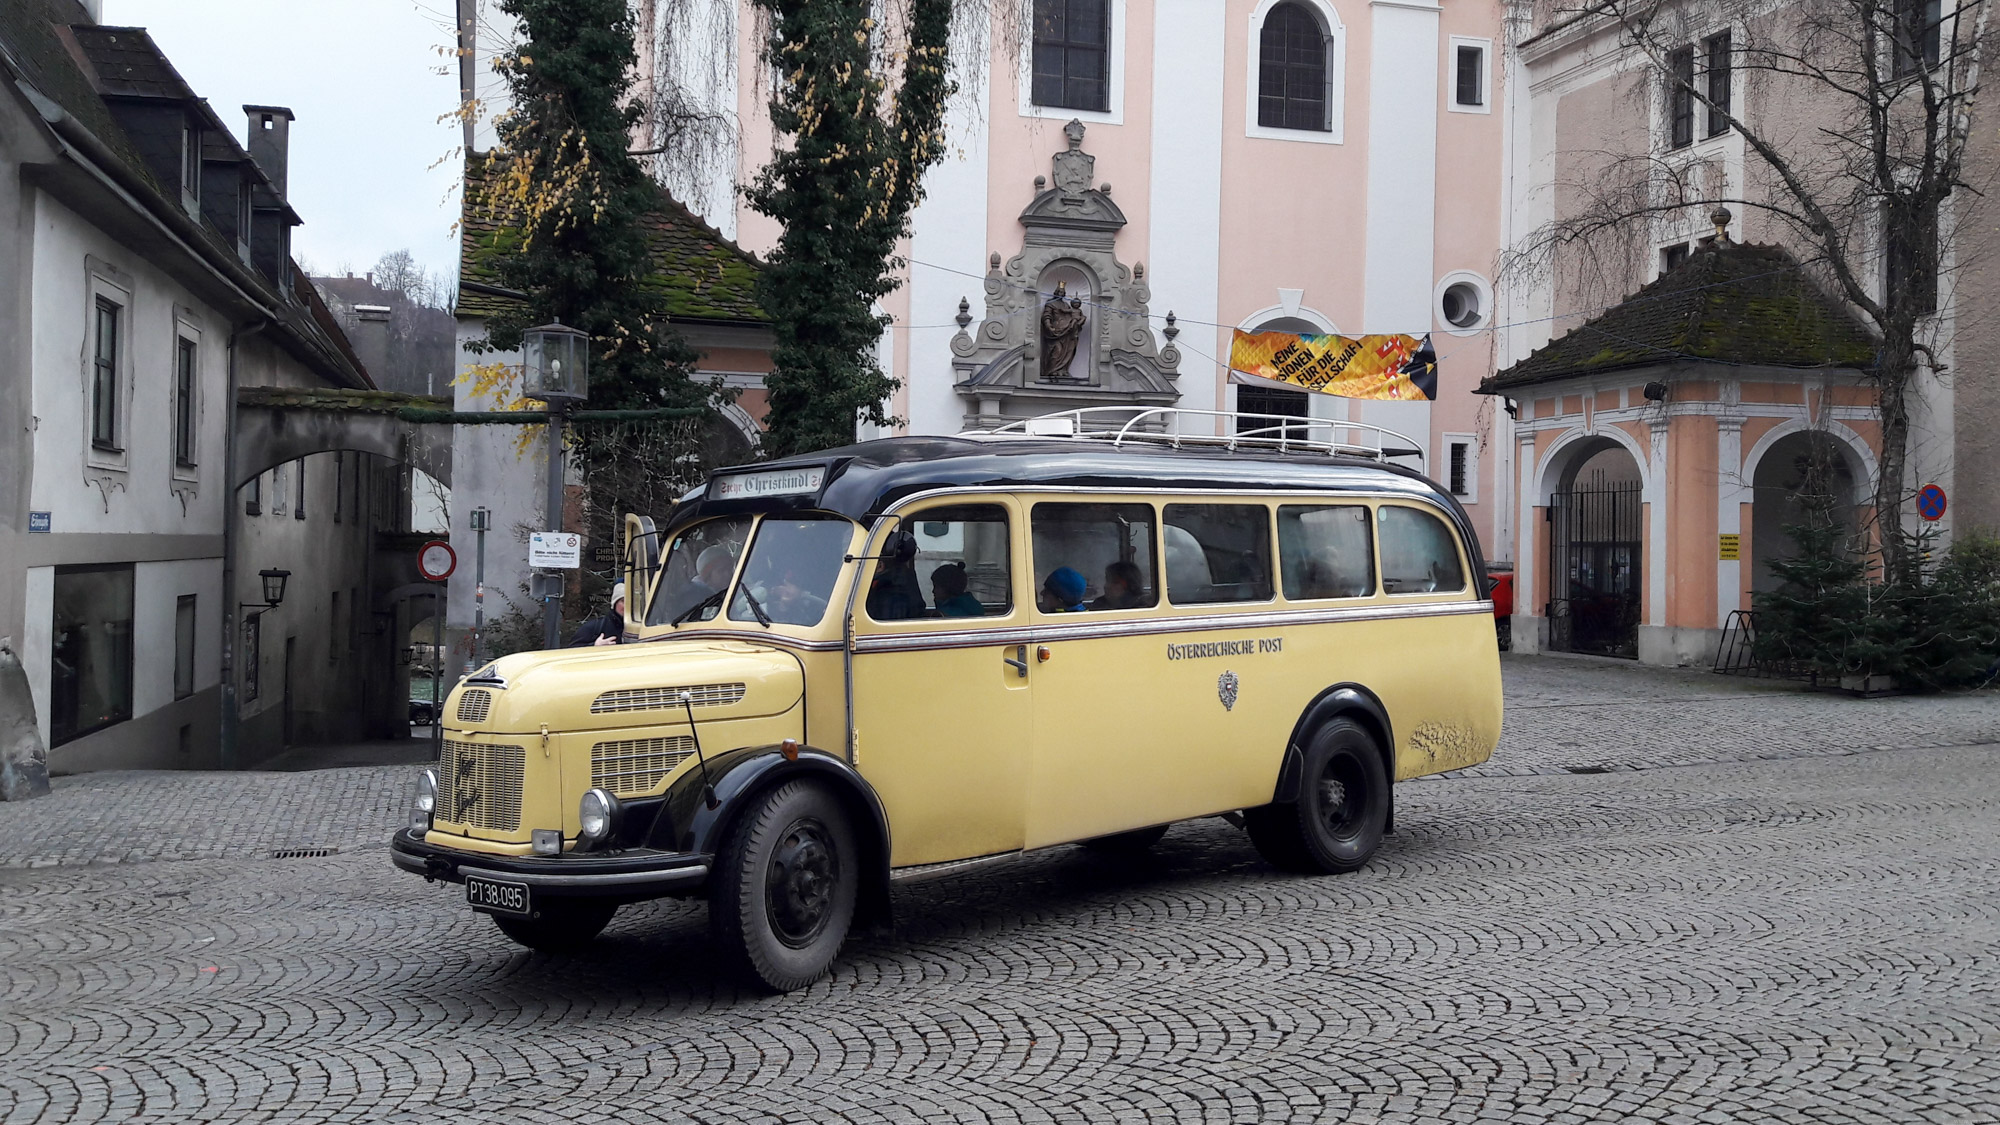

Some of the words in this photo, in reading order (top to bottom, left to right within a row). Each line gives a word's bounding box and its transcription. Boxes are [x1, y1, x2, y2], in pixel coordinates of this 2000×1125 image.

[1270, 340, 1300, 370] MEINE
[1277, 348, 1315, 382] SIONEN
[1296, 364, 1320, 386] FÜR
[1317, 349, 1336, 370] DIE
[1307, 340, 1363, 391] SELLSCHAFT
[744, 472, 809, 494] Christkindl
[1167, 640, 1254, 661] ÖSTERREICHISCHE
[1259, 638, 1283, 653] POST
